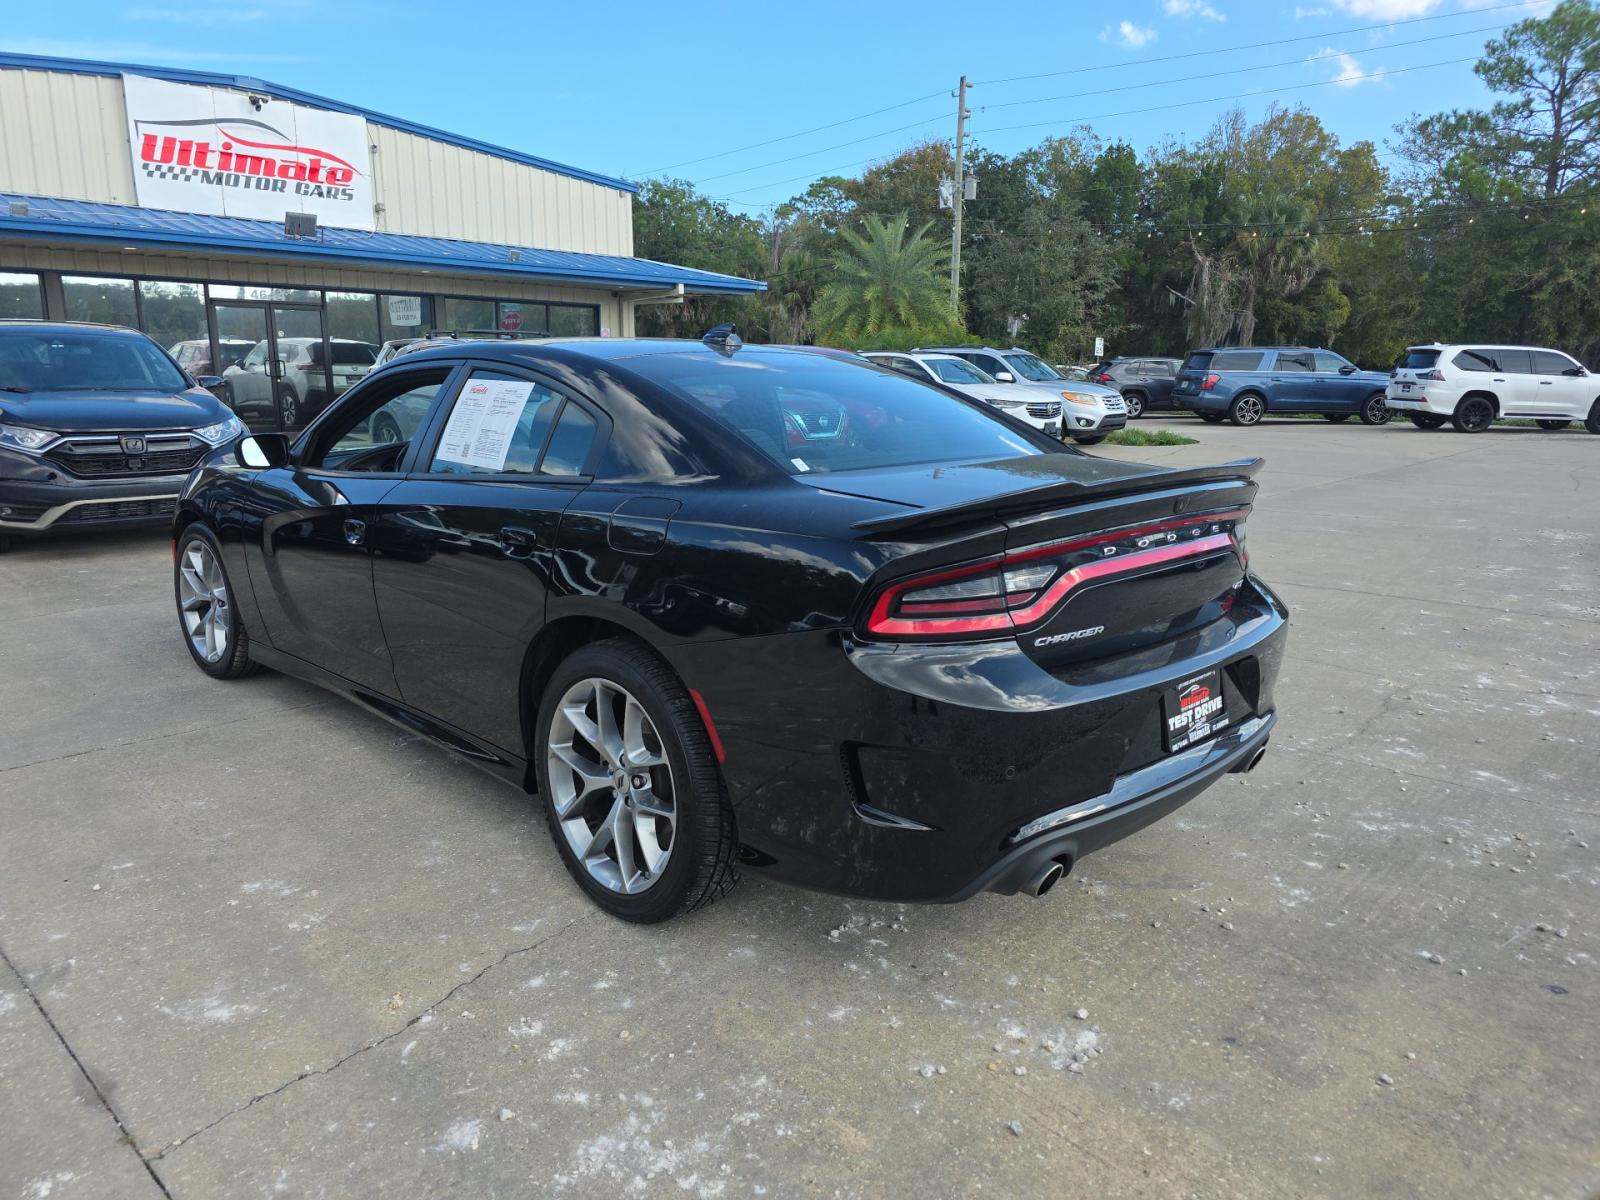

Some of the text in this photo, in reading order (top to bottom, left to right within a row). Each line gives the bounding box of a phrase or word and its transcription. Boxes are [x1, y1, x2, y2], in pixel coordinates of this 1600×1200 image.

[140, 133, 354, 187] Ultimate
[200, 169, 354, 201] MOTOR CARS
[1103, 524, 1220, 556] DODGE
[1034, 625, 1105, 647] CHARGER
[1168, 709, 1195, 731] TEST
[1194, 695, 1223, 720] DRIVE
